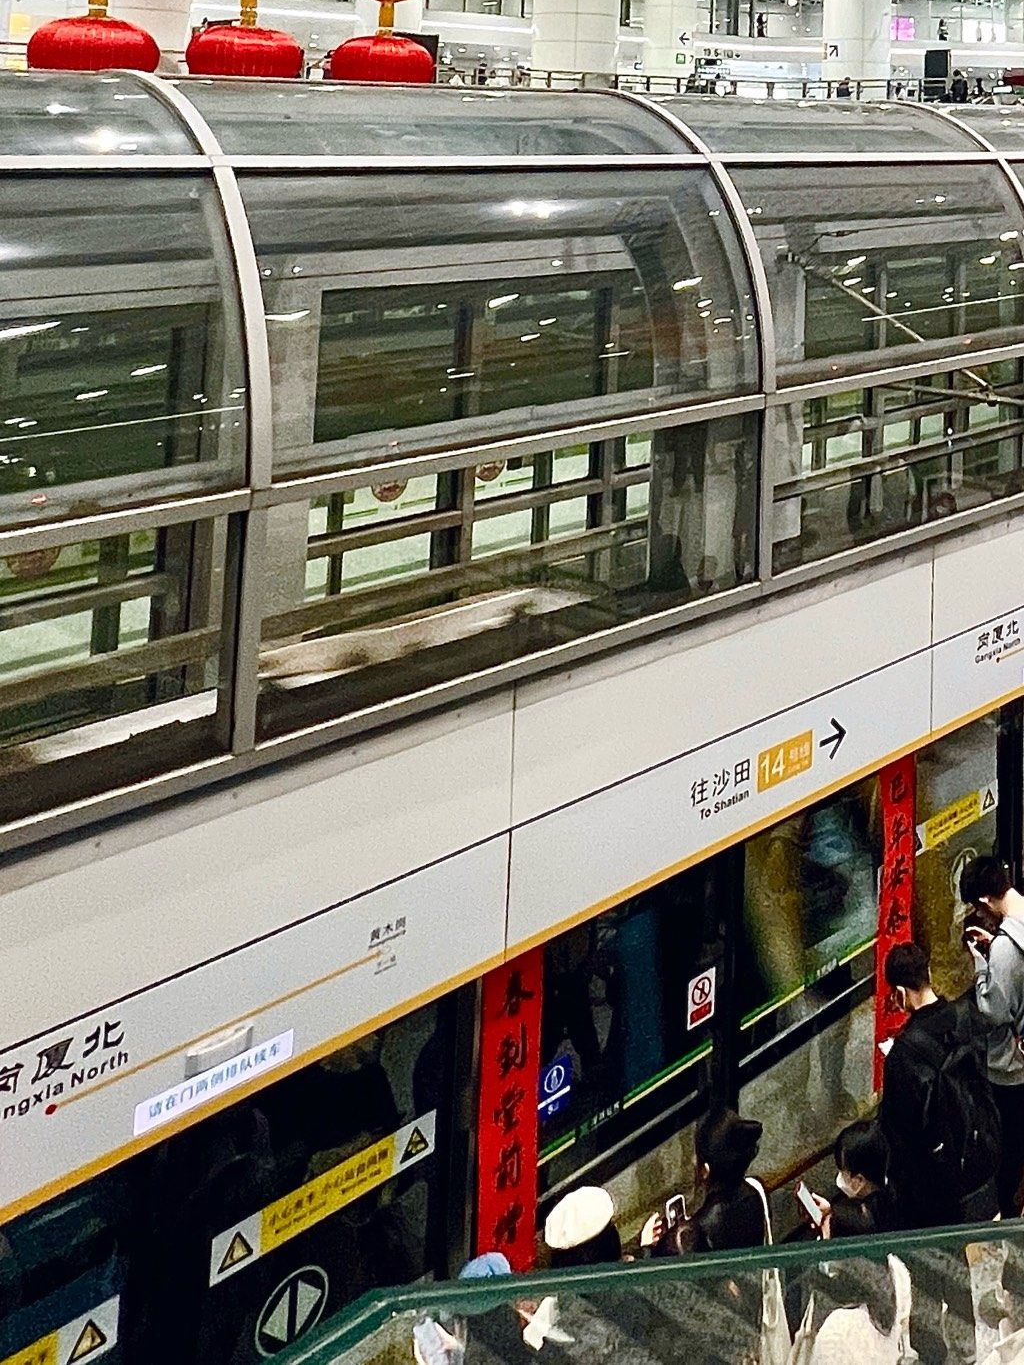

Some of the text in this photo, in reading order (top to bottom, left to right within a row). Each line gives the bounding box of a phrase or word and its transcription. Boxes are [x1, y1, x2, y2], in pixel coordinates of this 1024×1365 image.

[690, 758, 751, 807] 往沙田
[760, 748, 786, 785] 14
[700, 790, 750, 820] To Shatian
[71, 1050, 128, 1088] North
